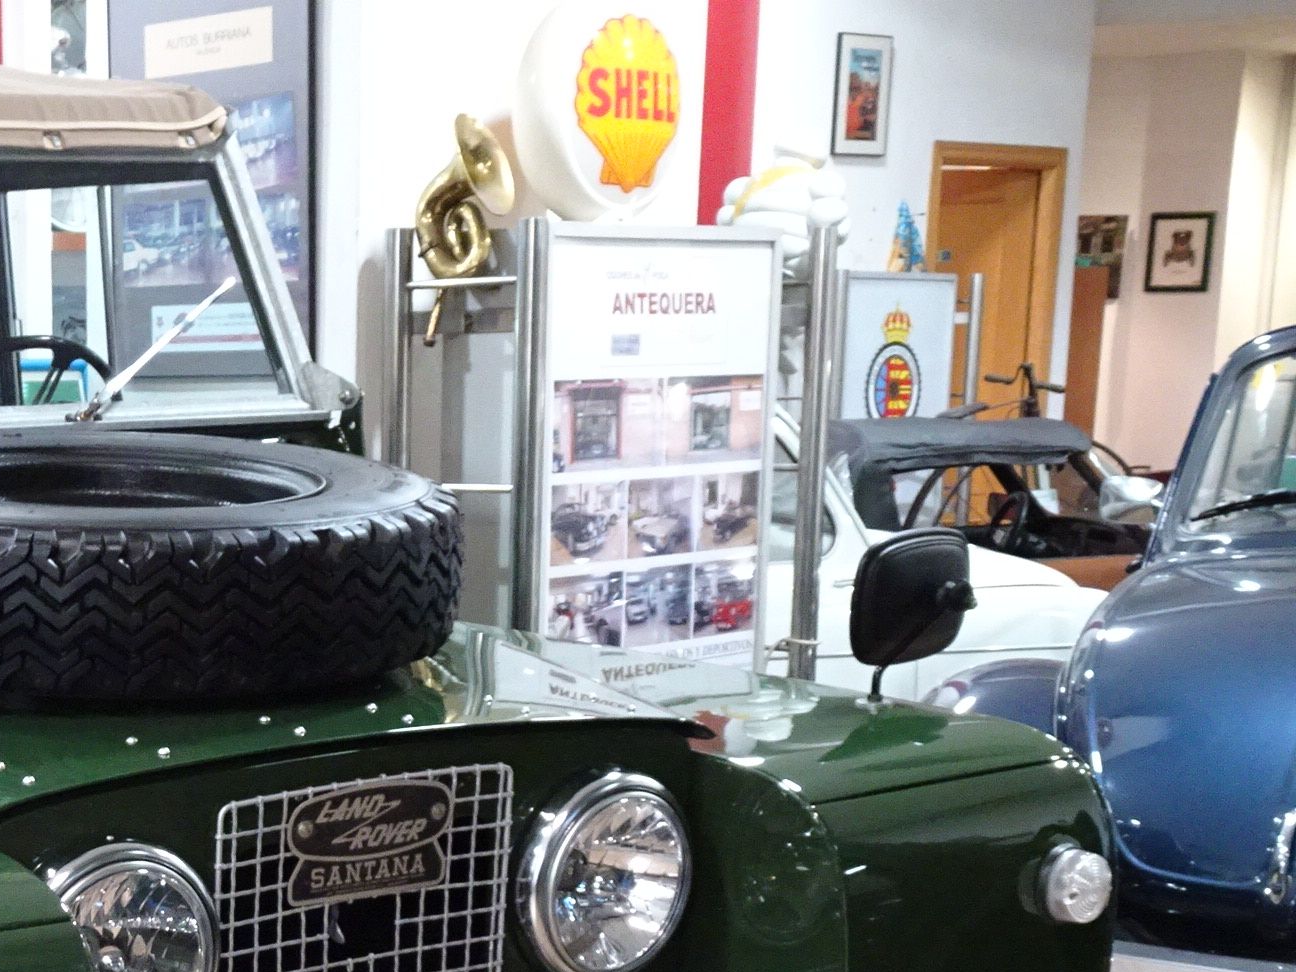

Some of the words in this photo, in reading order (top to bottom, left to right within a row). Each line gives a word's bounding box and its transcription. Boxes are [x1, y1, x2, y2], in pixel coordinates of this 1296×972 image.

[586, 67, 676, 123] SHELL
[612, 292, 716, 315] ANTEQUERA
[315, 794, 387, 824] LAND
[349, 818, 427, 850] ROVER
[310, 853, 426, 889] SANTANA
